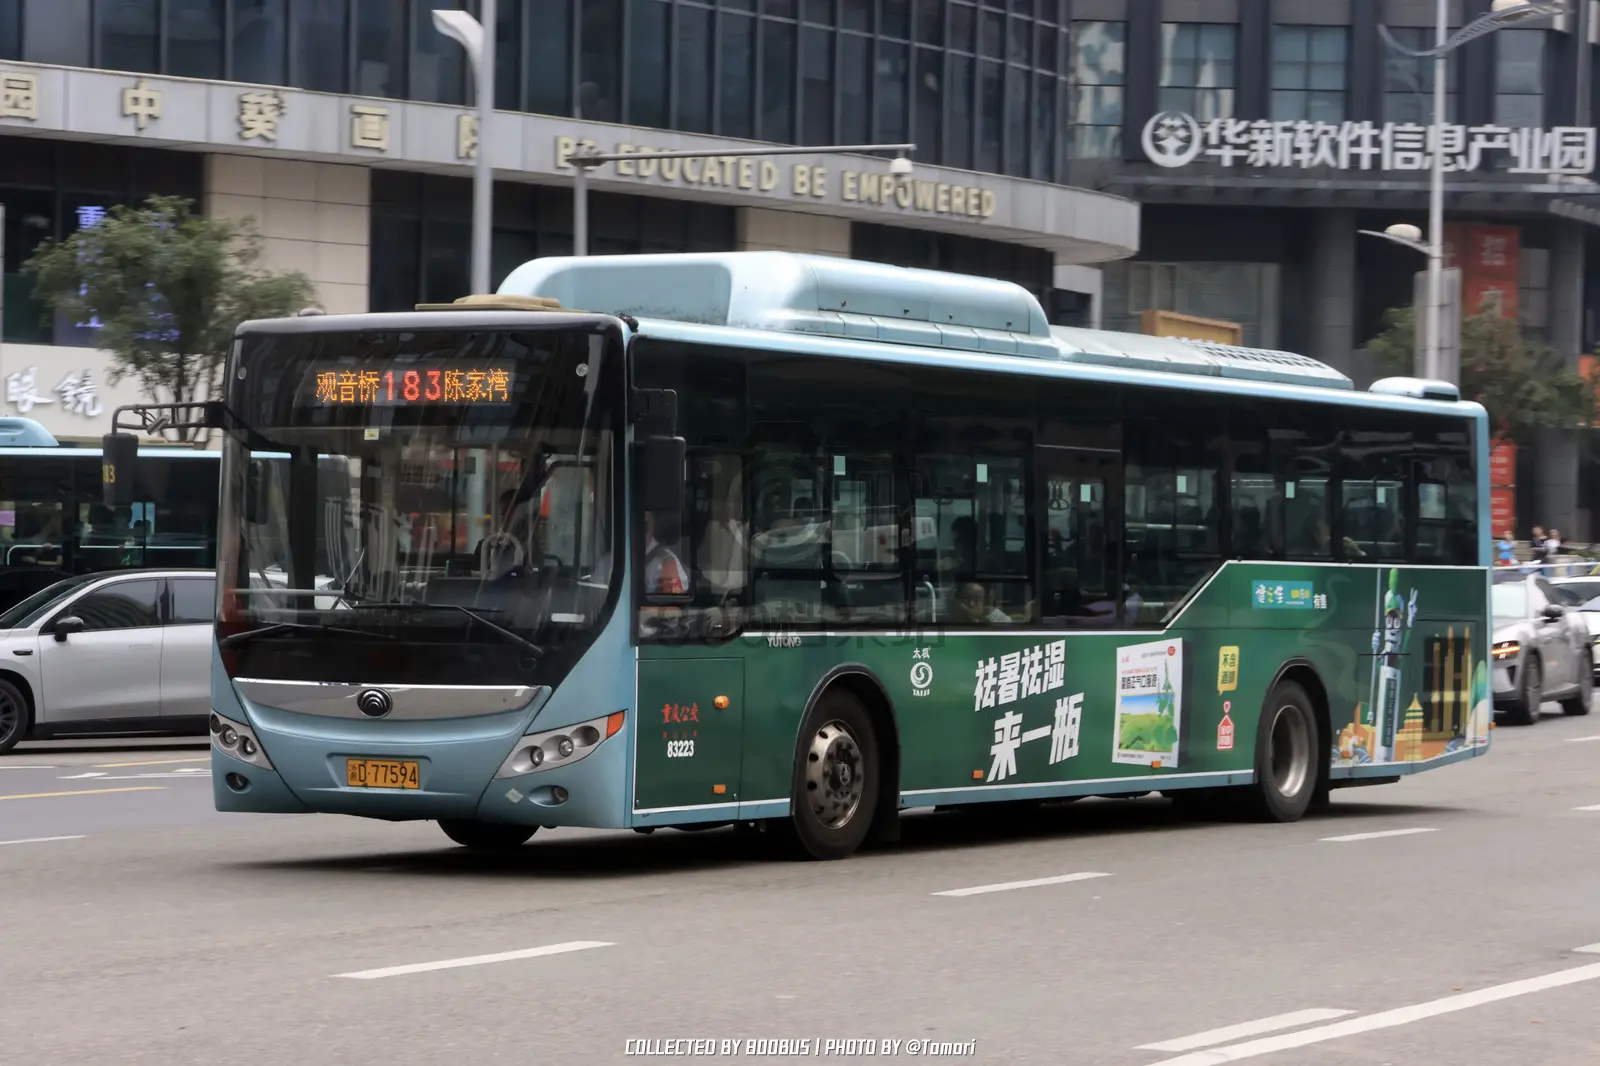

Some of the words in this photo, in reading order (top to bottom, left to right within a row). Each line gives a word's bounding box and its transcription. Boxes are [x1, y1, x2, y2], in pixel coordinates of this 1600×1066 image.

[1205, 118, 1597, 174] 华新软件信息产业园
[617, 142, 778, 191] EDUCATED
[793, 164, 828, 197] BE
[842, 169, 997, 217] EMPOWERED
[316, 370, 381, 403] 观音桥
[383, 370, 441, 401] 183
[444, 368, 509, 402] 陈家湾
[767, 636, 802, 648] YUTONG
[974, 639, 1066, 712] 祛暑祛湿
[667, 740, 694, 758] 83223
[986, 692, 1085, 783] 来一瓶
